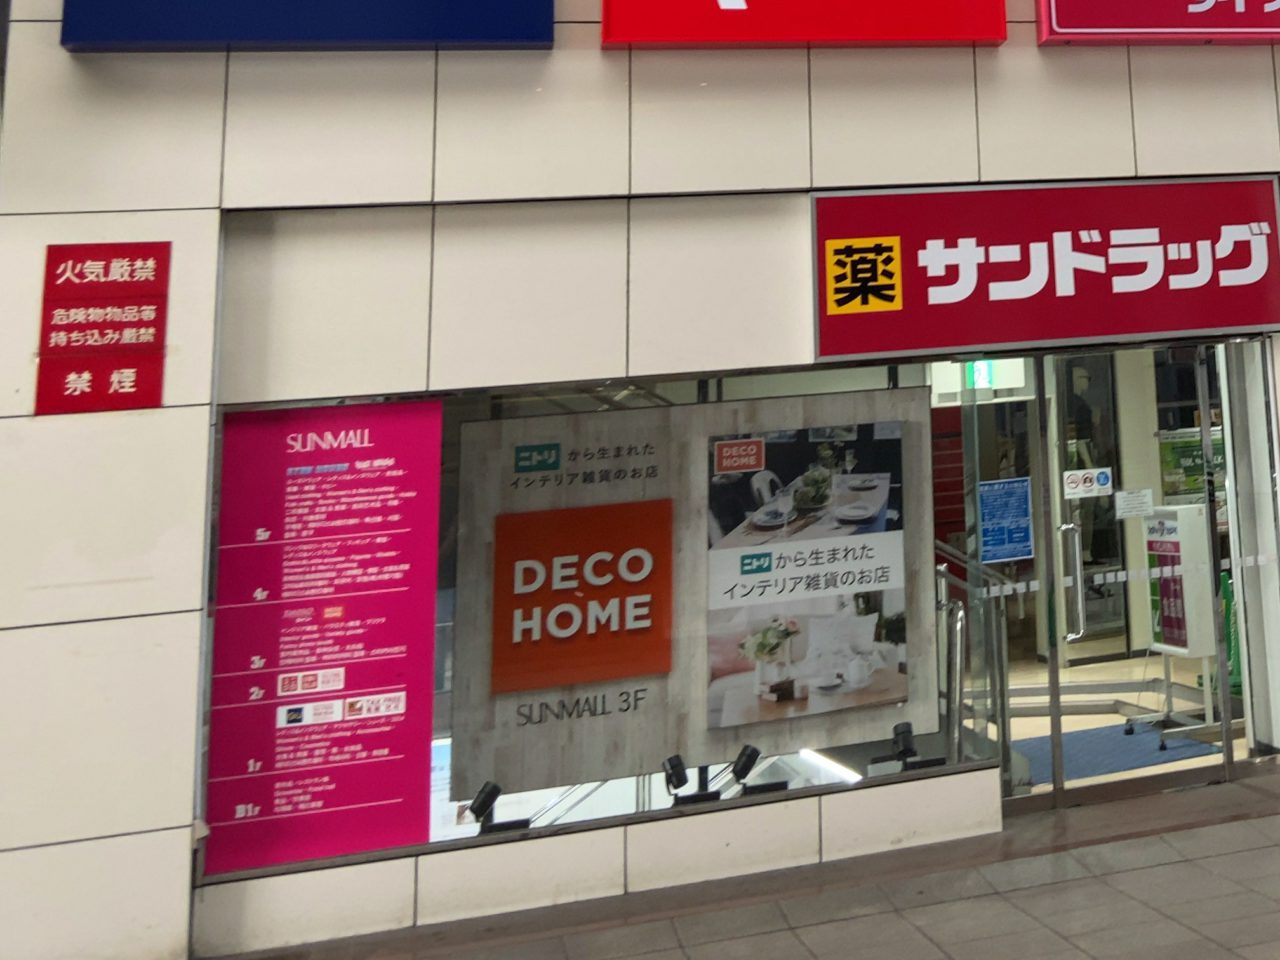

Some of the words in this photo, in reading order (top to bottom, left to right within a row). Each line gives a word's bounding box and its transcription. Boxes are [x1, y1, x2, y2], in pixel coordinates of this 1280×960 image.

[54, 257, 157, 285] 火気厳禁
[831, 242, 897, 307] 薬
[917, 221, 1273, 306] サンドラッグ
[49, 327, 157, 348] 持ち込み厳禁
[286, 428, 375, 453] SUNMALL
[722, 444, 757, 457] DECO
[516, 448, 558, 468] ニトリ
[567, 442, 656, 463] から生まれた
[722, 455, 757, 467] HOME
[510, 464, 660, 490] インテリア雑貨のお店
[742, 557, 771, 571] ニトリ
[775, 544, 876, 570] から生まれた
[513, 547, 654, 596] DECO
[723, 566, 891, 600] インテリア雑貨のお店
[512, 593, 653, 644] HOME
[516, 695, 612, 728] SUNMALL
[618, 688, 648, 714] 3F
